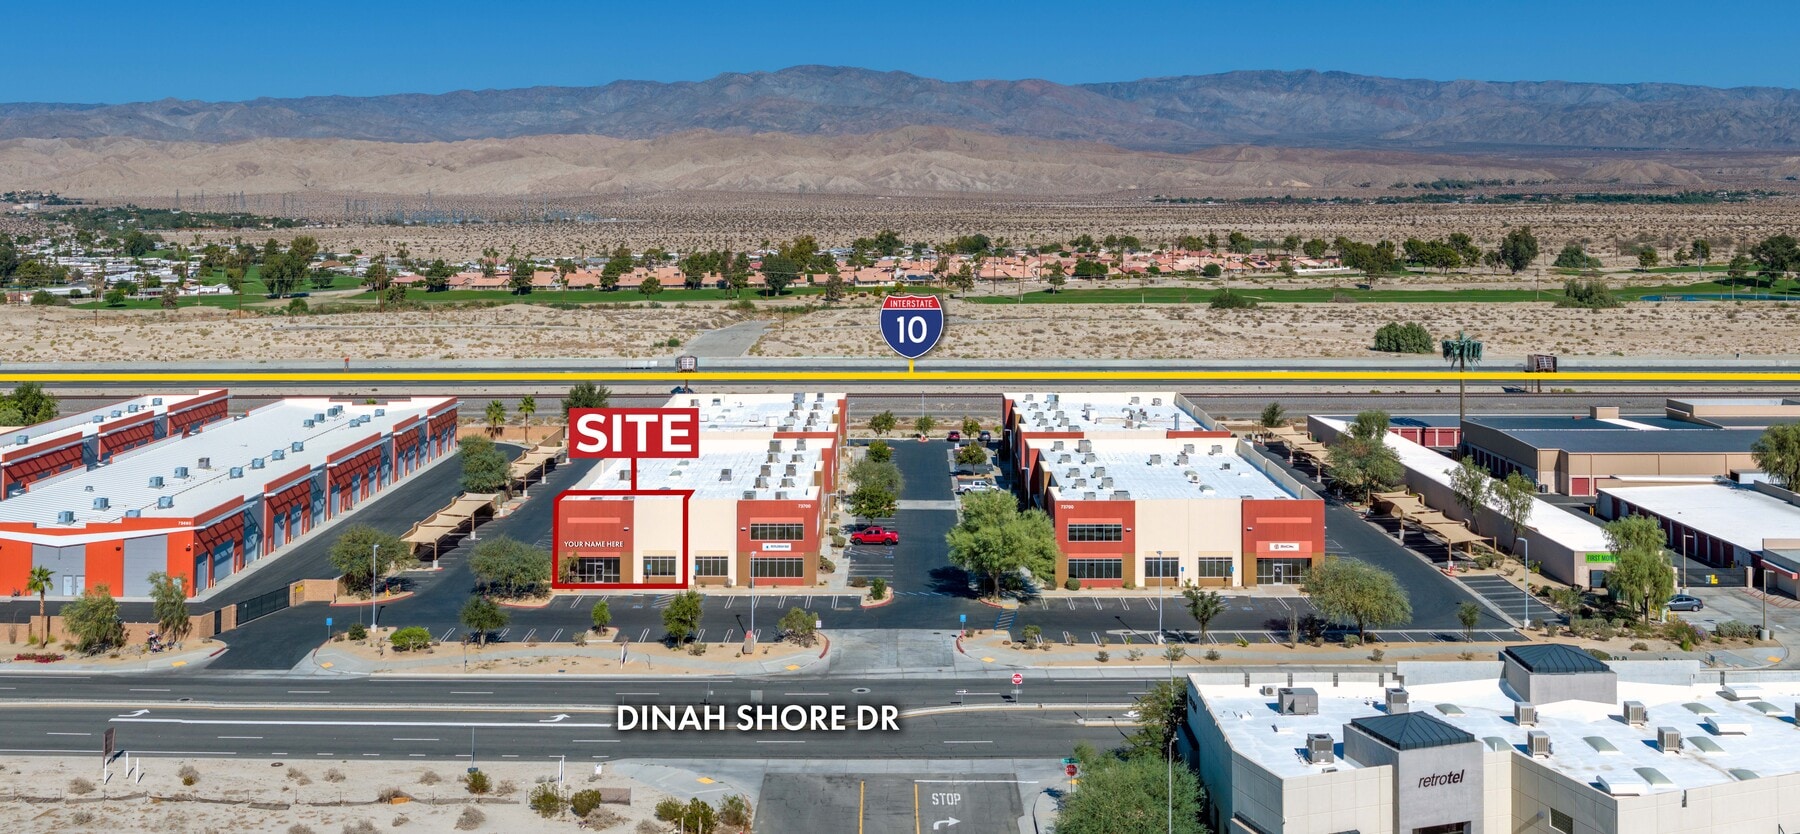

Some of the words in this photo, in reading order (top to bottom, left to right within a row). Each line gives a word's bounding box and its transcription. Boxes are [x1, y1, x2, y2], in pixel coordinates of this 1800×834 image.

[1587, 554, 1600, 562] FIRST
[1418, 769, 1465, 788] retrotel
[932, 793, 961, 806] STOP
